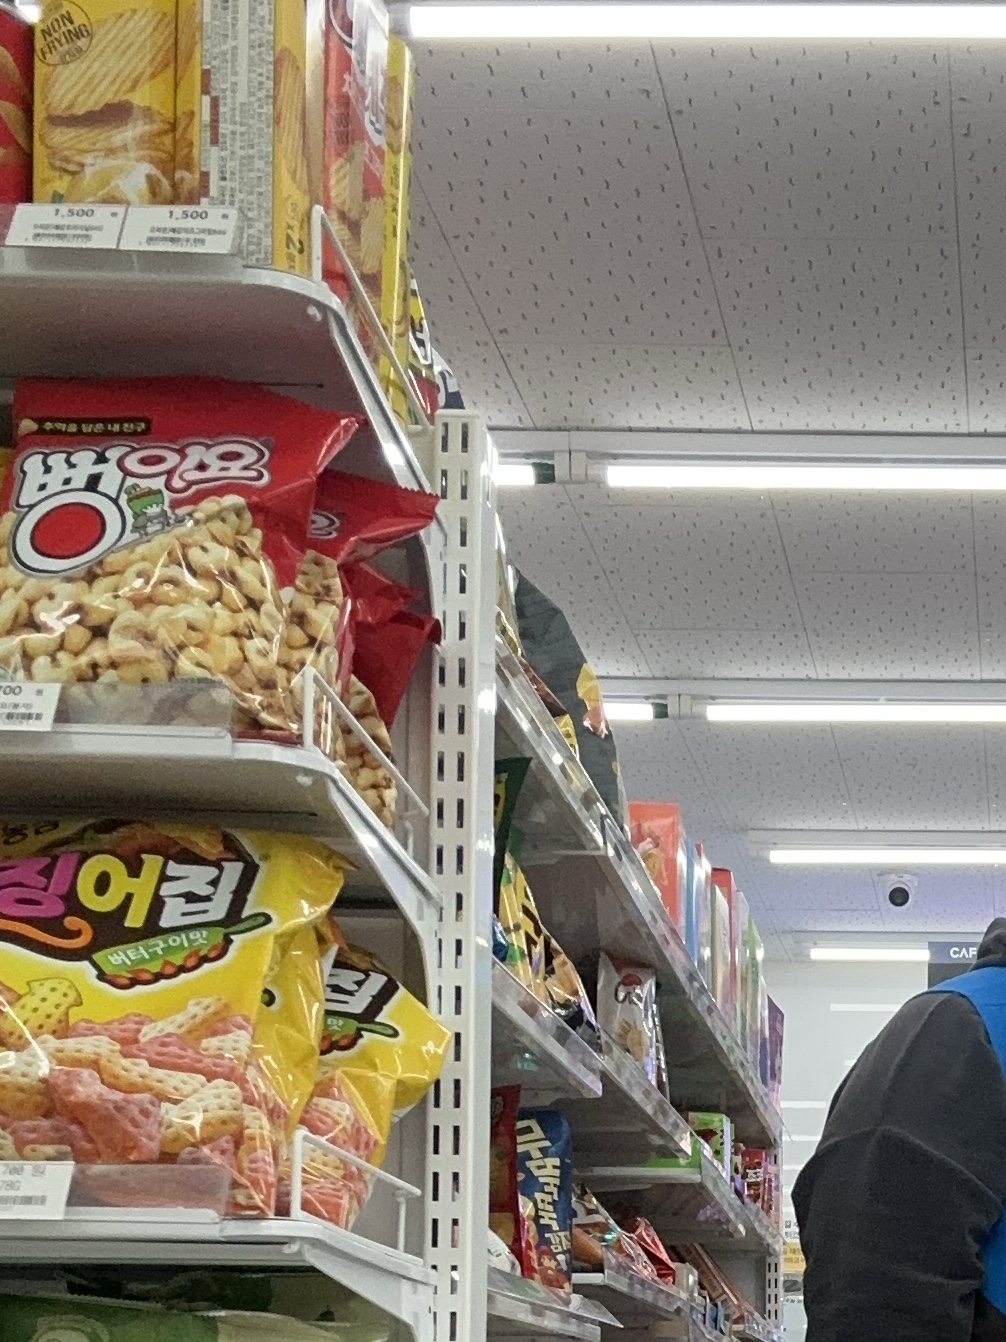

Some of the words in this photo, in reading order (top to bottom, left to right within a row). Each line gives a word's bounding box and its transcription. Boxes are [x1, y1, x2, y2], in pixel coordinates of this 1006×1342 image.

[39, 23, 91, 61] FRYING
[41, 11, 75, 42] NON
[54, 208, 95, 218] 1,500
[168, 210, 209, 220] 1,500
[12, 440, 268, 574] 뻥이요
[107, 930, 209, 966] 버터구이맛
[950, 947, 978, 958] CAF
